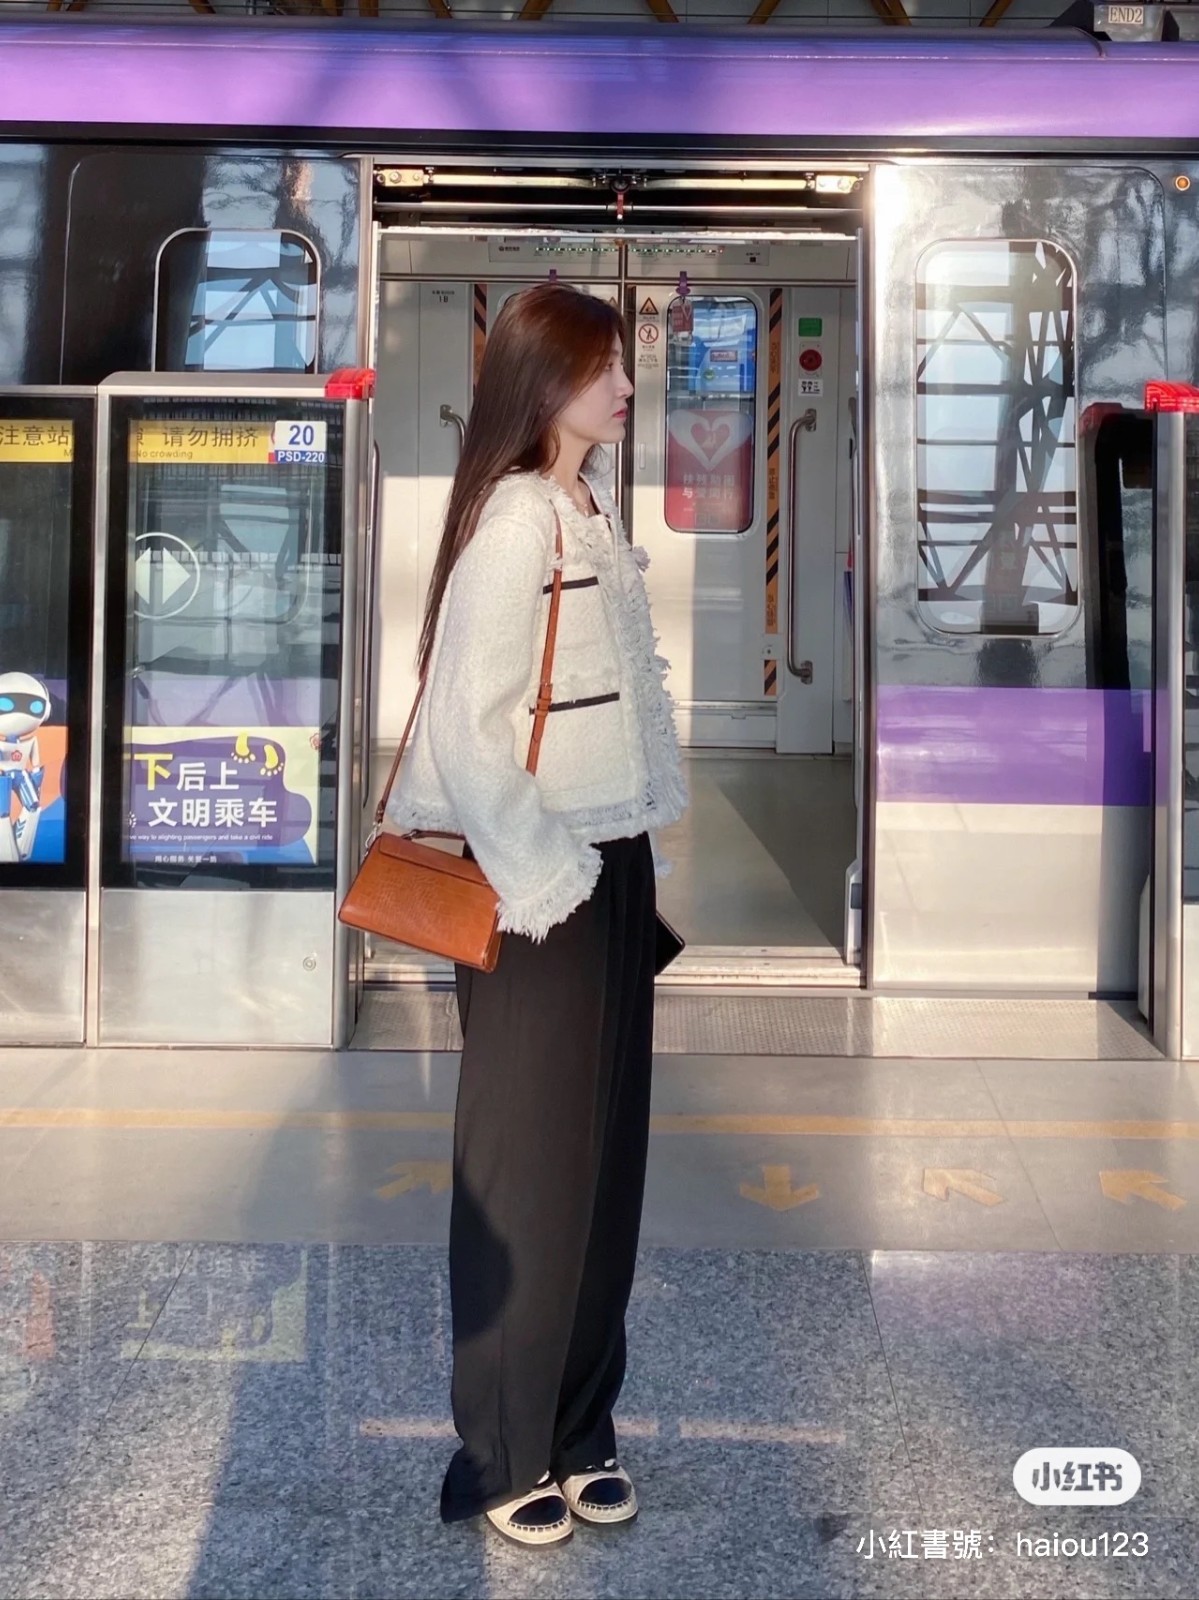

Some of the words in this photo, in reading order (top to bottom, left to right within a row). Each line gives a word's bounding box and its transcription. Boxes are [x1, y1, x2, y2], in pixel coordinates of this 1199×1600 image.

[1110, 7, 1142, 22] END2
[0, 425, 70, 446] 注意站
[162, 426, 258, 447] 请勿拥挤
[288, 424, 314, 446] 20
[150, 450, 193, 460] crowding
[277, 451, 325, 463] PSD-220
[134, 753, 239, 791] 下后上
[148, 797, 277, 828] 文明乘车
